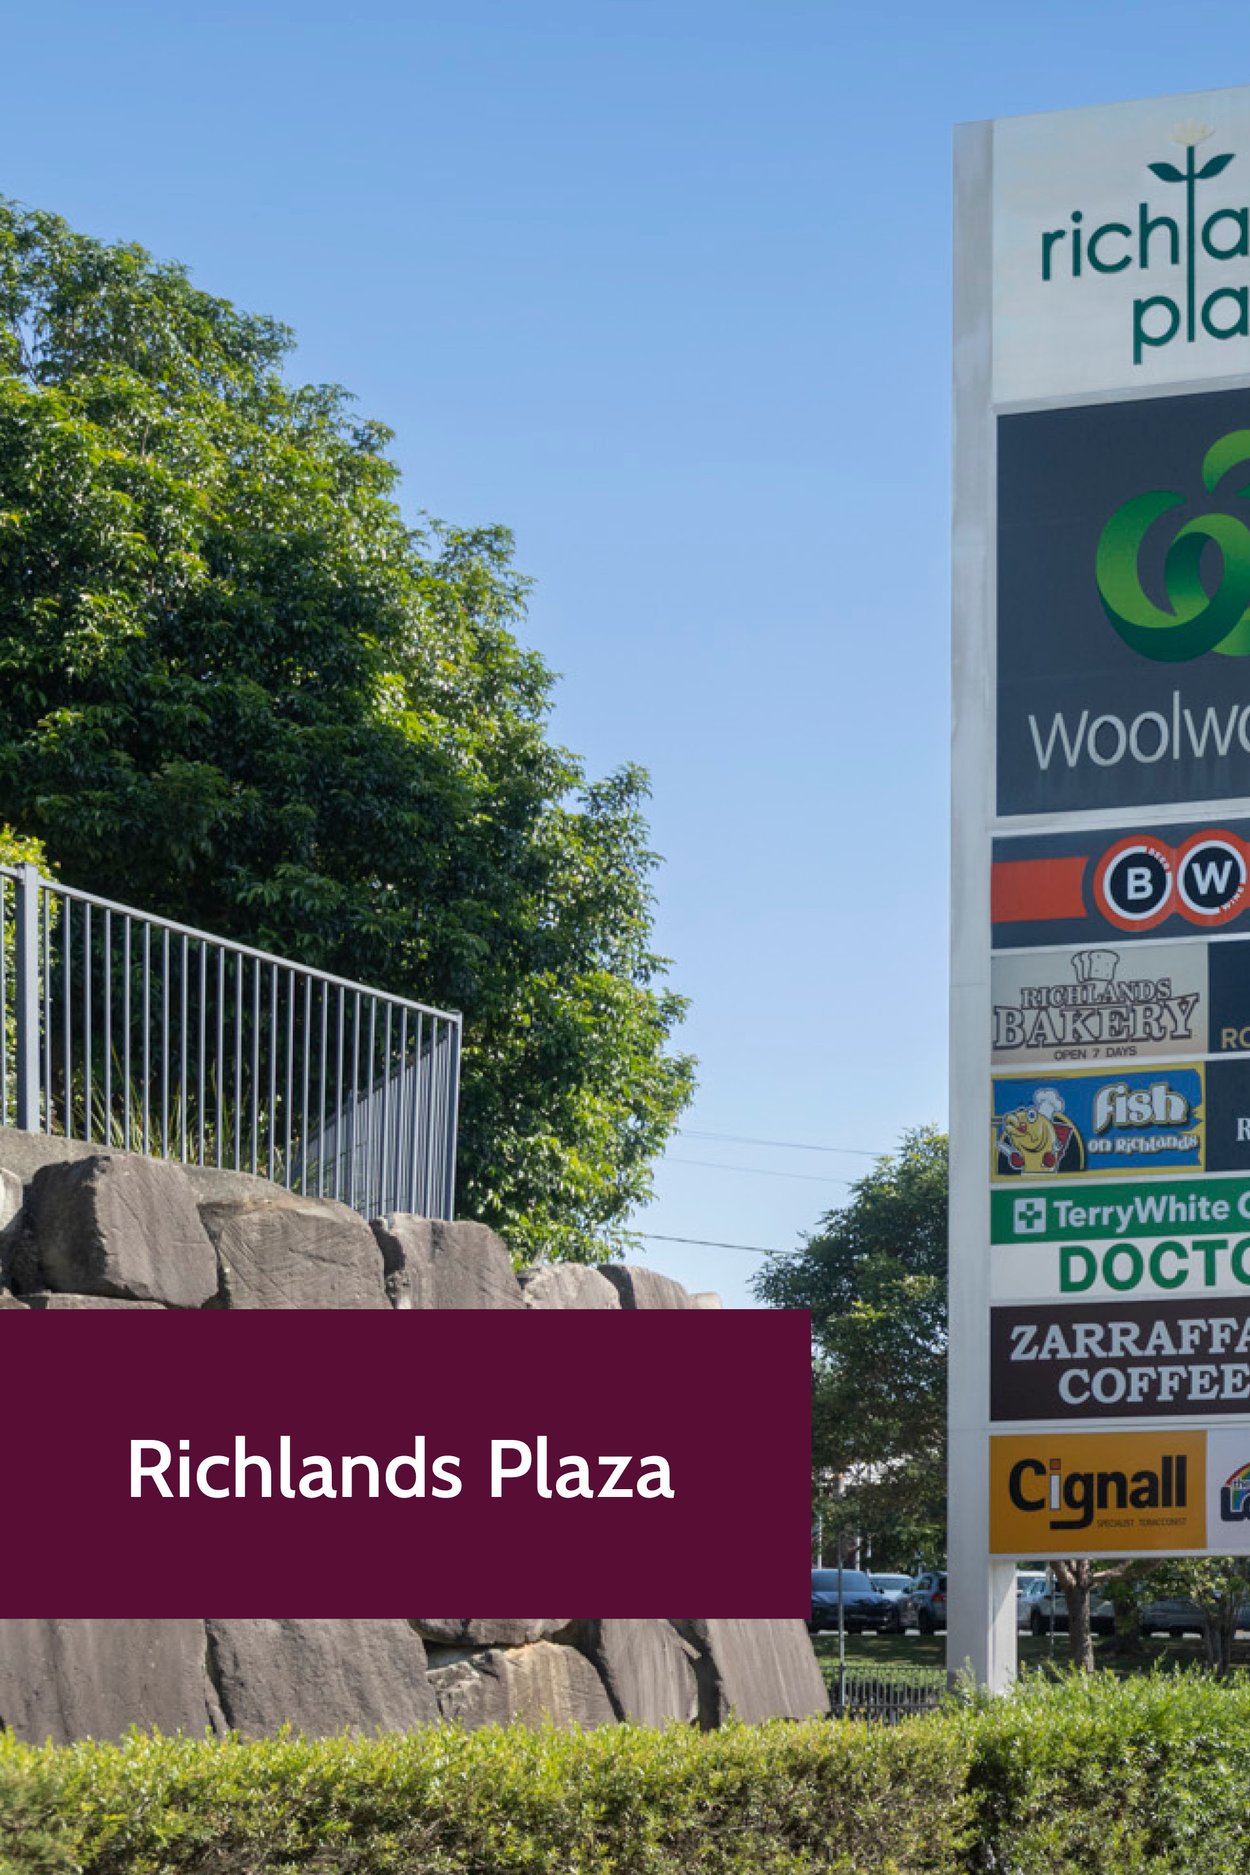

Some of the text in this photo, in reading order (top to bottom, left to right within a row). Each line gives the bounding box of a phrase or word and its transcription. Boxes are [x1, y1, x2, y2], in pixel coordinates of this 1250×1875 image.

[1021, 977, 1172, 1009] RICHLANDS
[993, 993, 1199, 1050] BAKERY
[1054, 1045, 1137, 1061] OPEN 7 DAYS
[1094, 1082, 1189, 1134] fish
[1087, 1136, 1112, 1153] on
[1053, 1194, 1231, 1233] TerryWhite
[1009, 1455, 1188, 1530] Cignall
[1233, 1478, 1250, 1489] the
